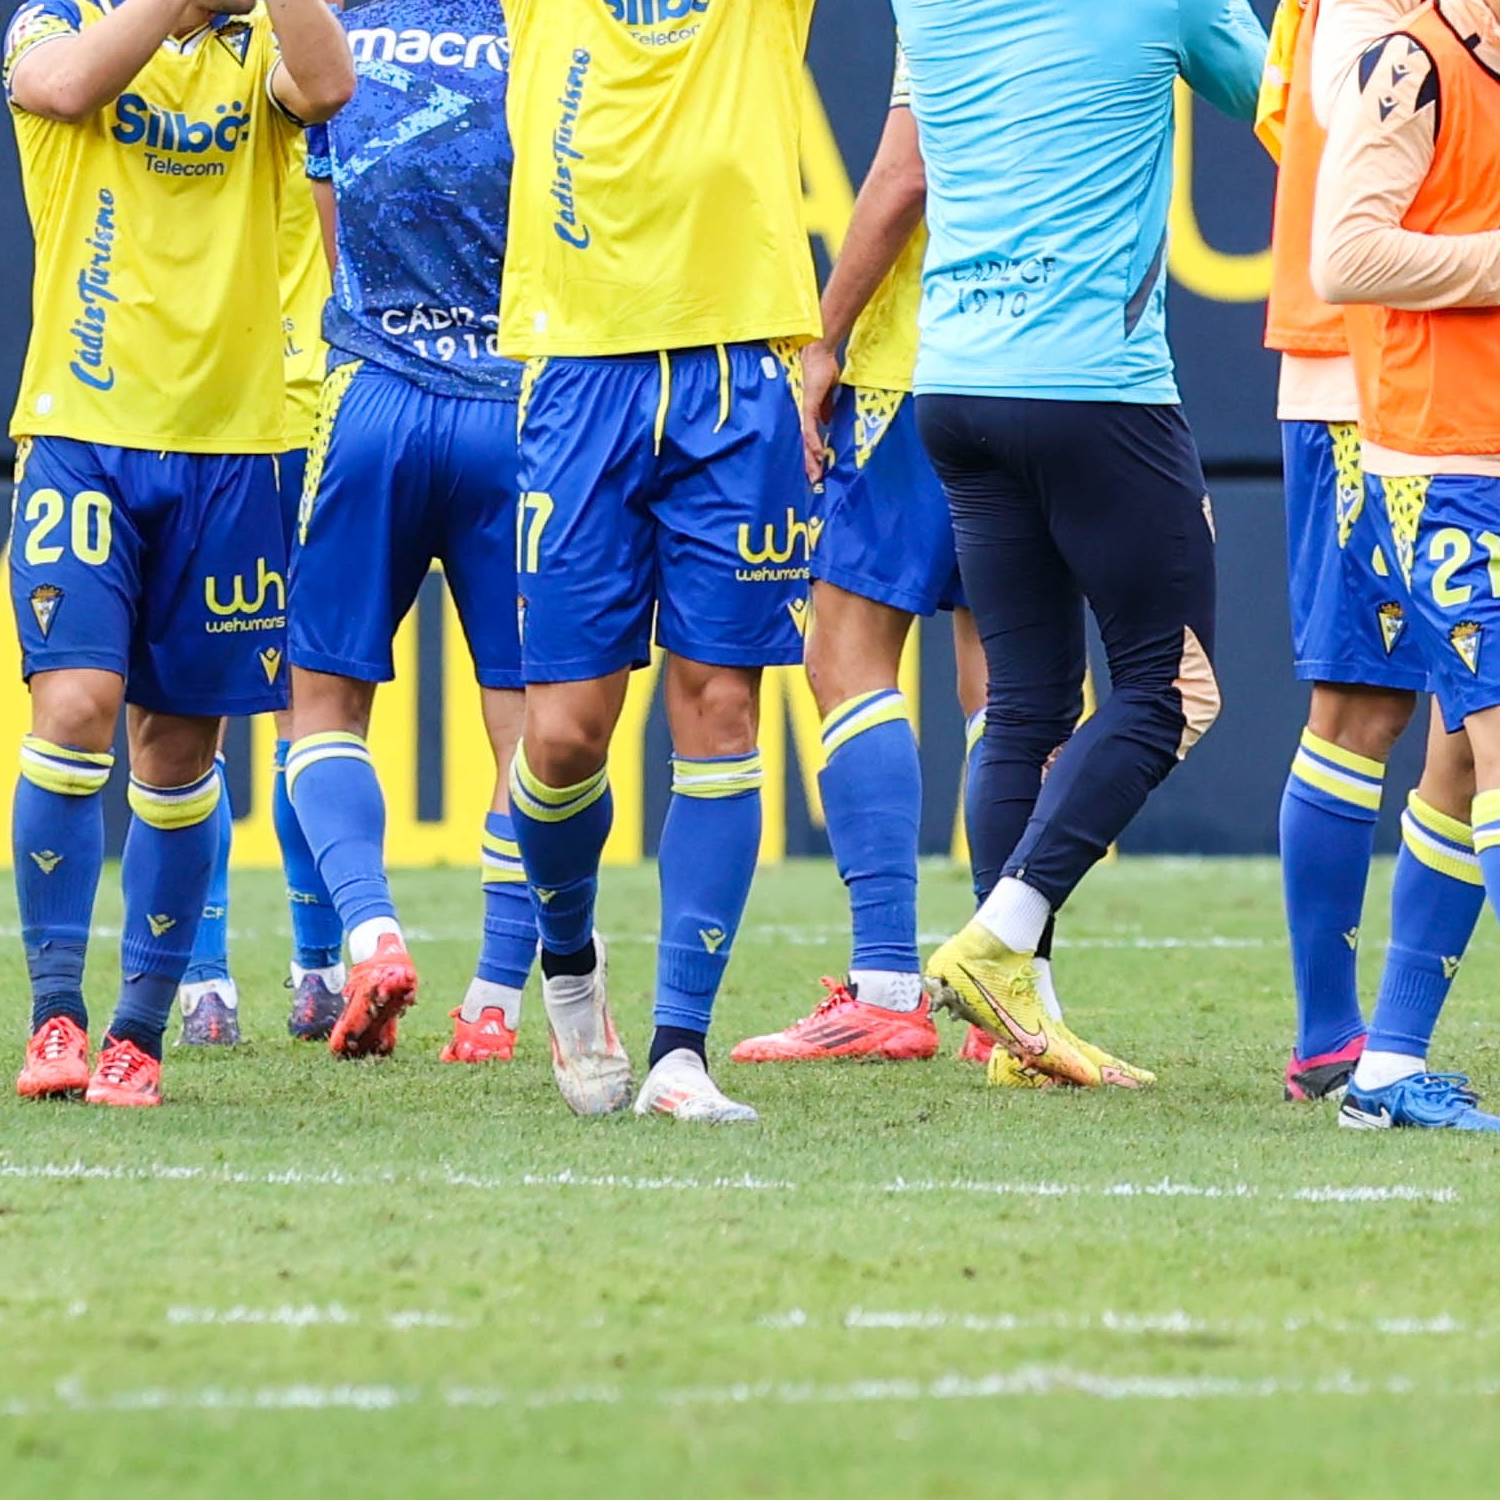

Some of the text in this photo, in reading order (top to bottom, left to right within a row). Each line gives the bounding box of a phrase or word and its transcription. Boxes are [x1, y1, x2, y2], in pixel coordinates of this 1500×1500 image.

[144, 152, 224, 176] Telecom
[25, 488, 113, 566] 20
[735, 567, 810, 582] wehumans
[205, 617, 286, 633] wehumans
